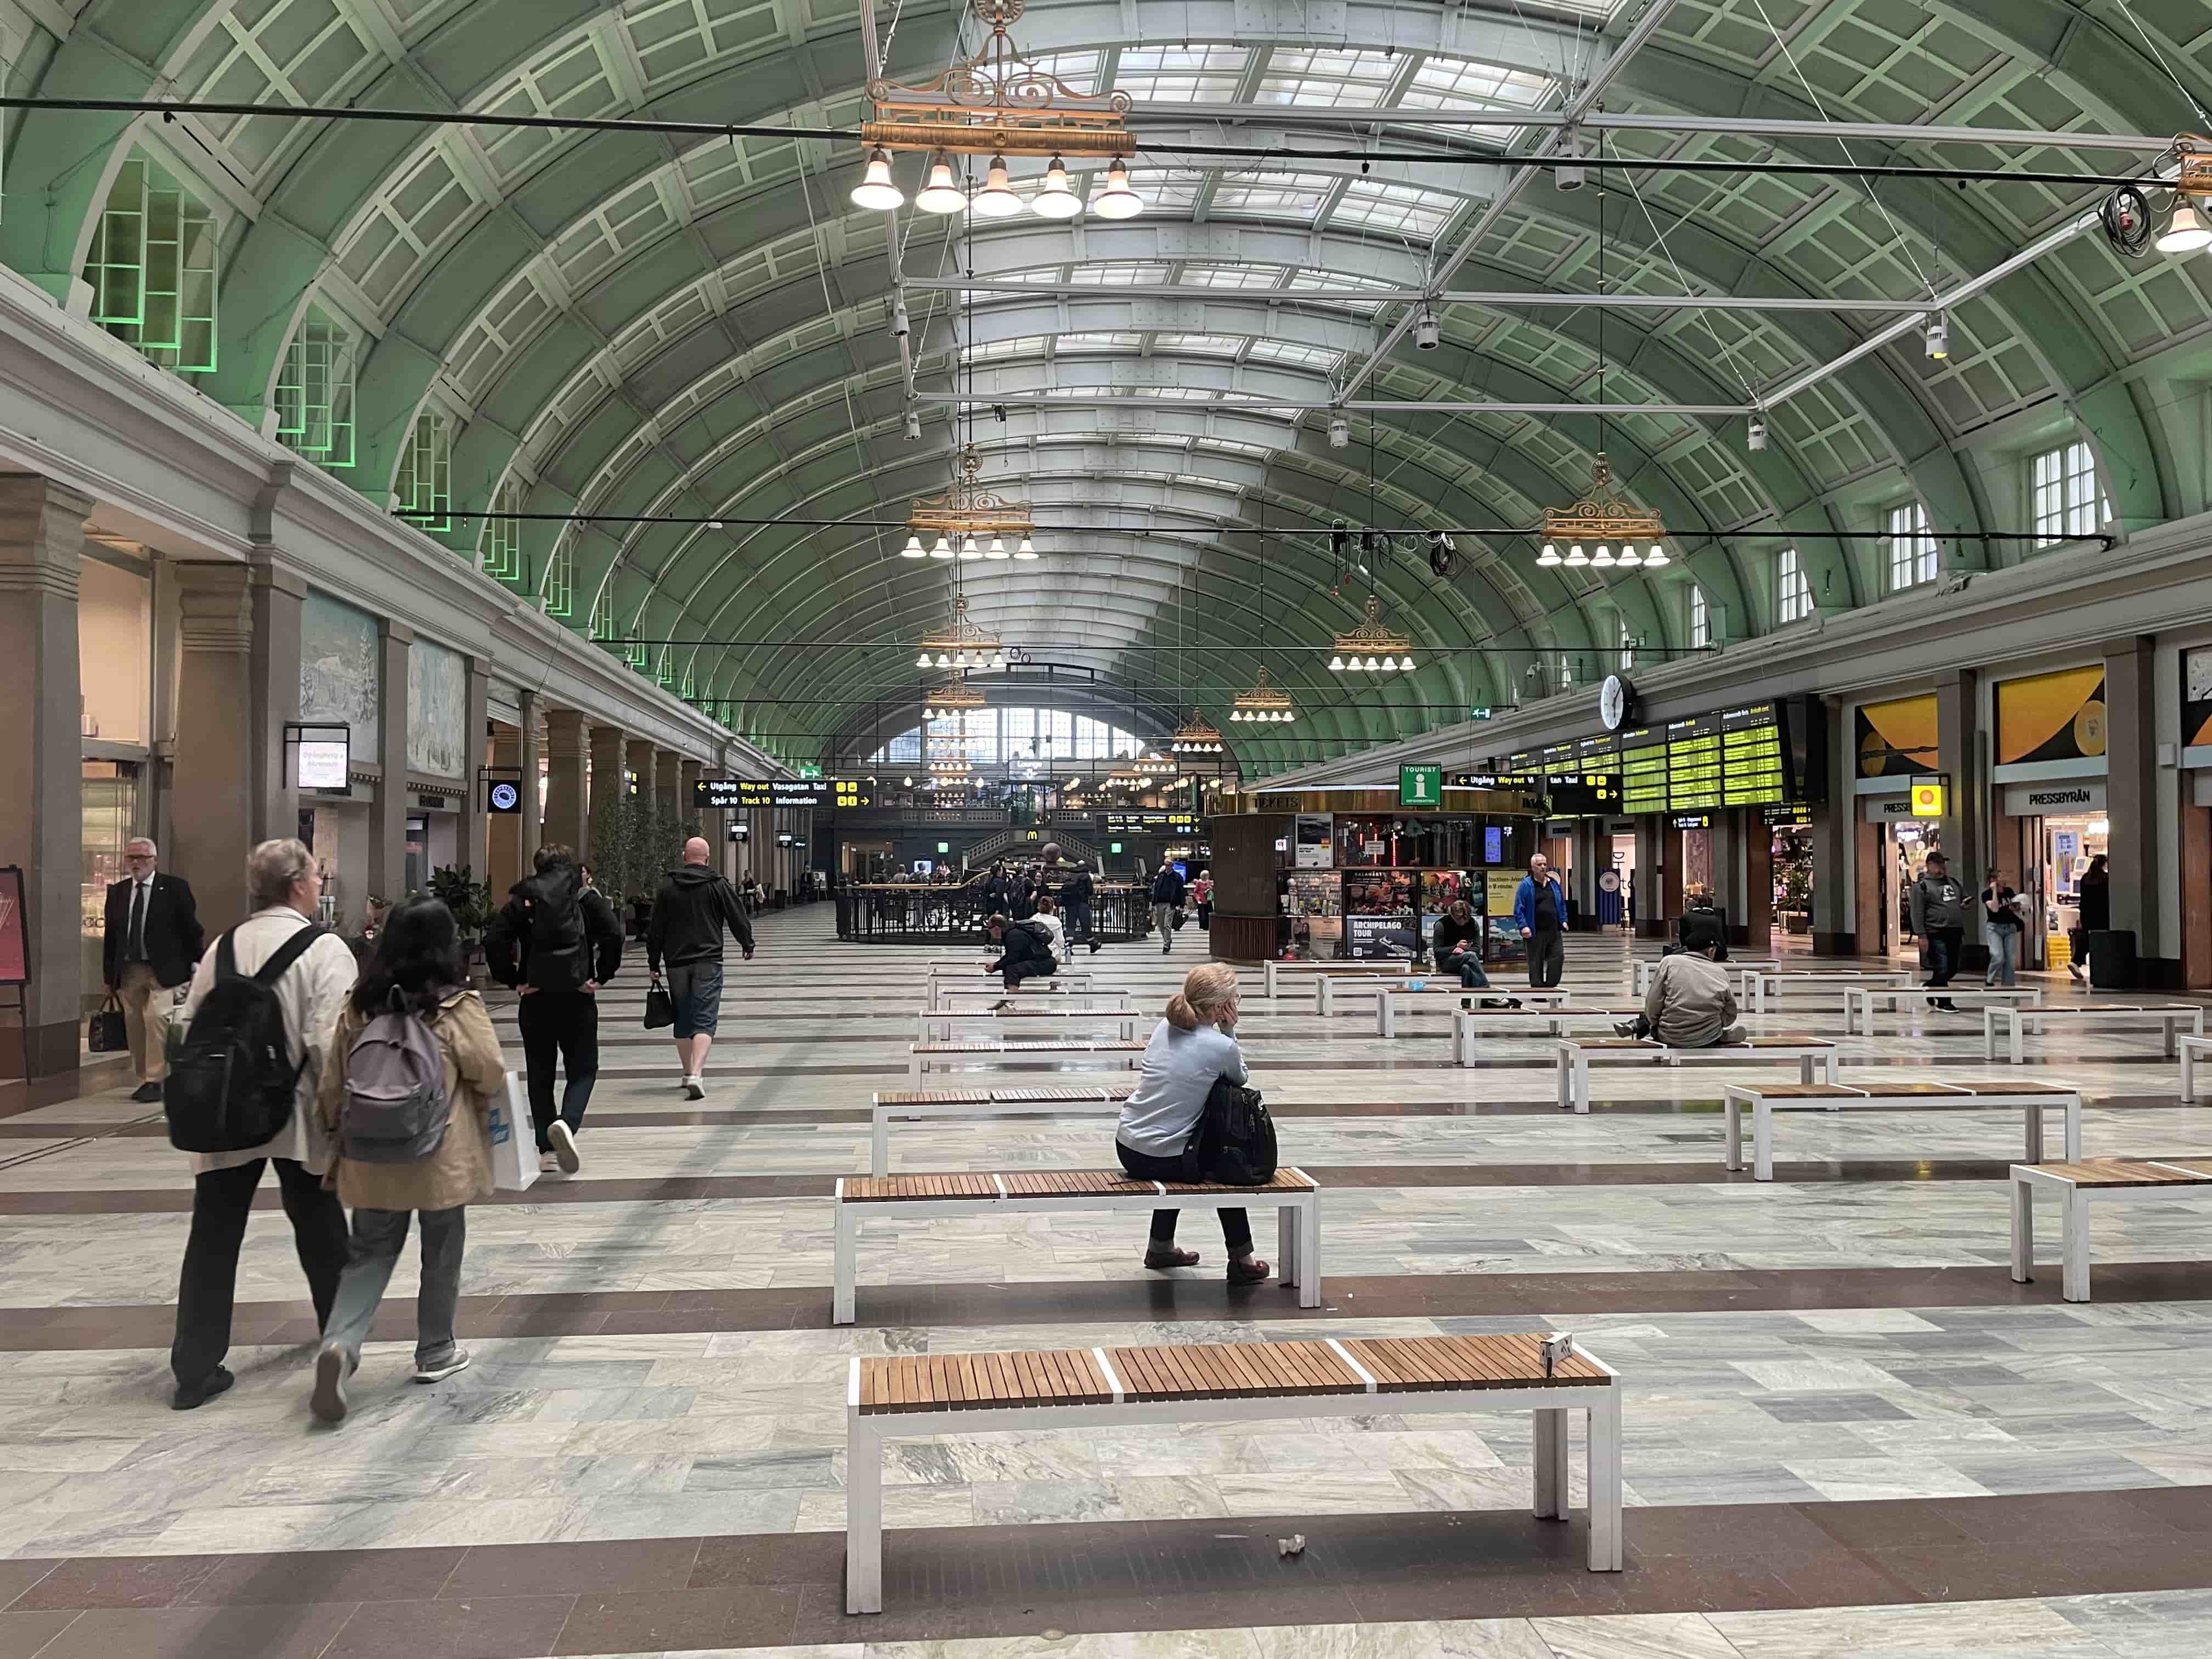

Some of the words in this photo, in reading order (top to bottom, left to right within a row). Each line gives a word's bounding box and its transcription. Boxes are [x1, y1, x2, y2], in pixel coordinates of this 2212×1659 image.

[1471, 776, 1494, 785] Utgång
[1498, 776, 1511, 785] Way
[710, 783, 736, 791] Utgång
[711, 797, 727, 805] Spår
[2029, 789, 2090, 805] PRESSBYRÅN
